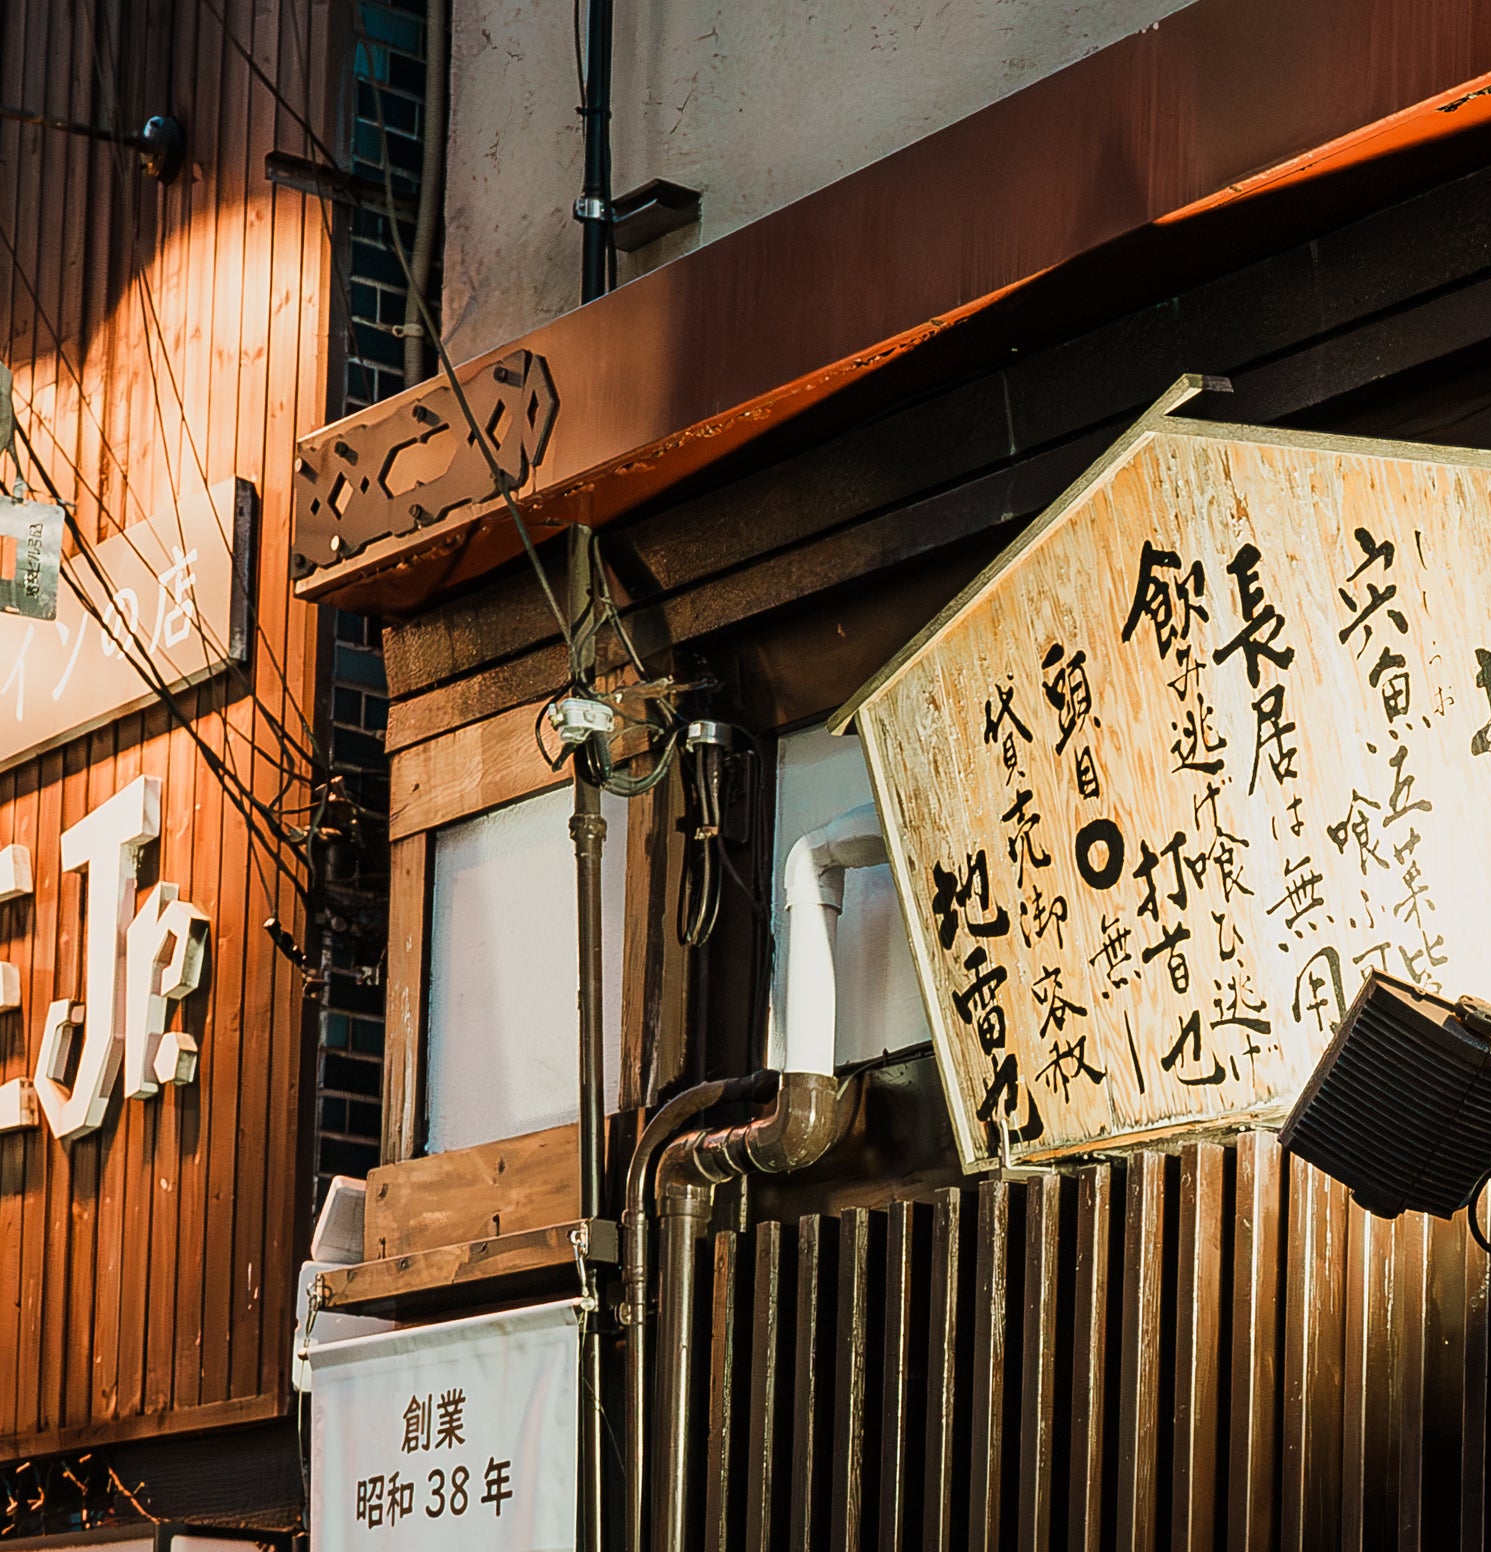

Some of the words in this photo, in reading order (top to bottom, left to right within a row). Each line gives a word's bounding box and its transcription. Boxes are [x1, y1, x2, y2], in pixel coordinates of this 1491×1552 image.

[931, 847, 1044, 1144] 地雷也
[402, 1387, 467, 1455] 創業
